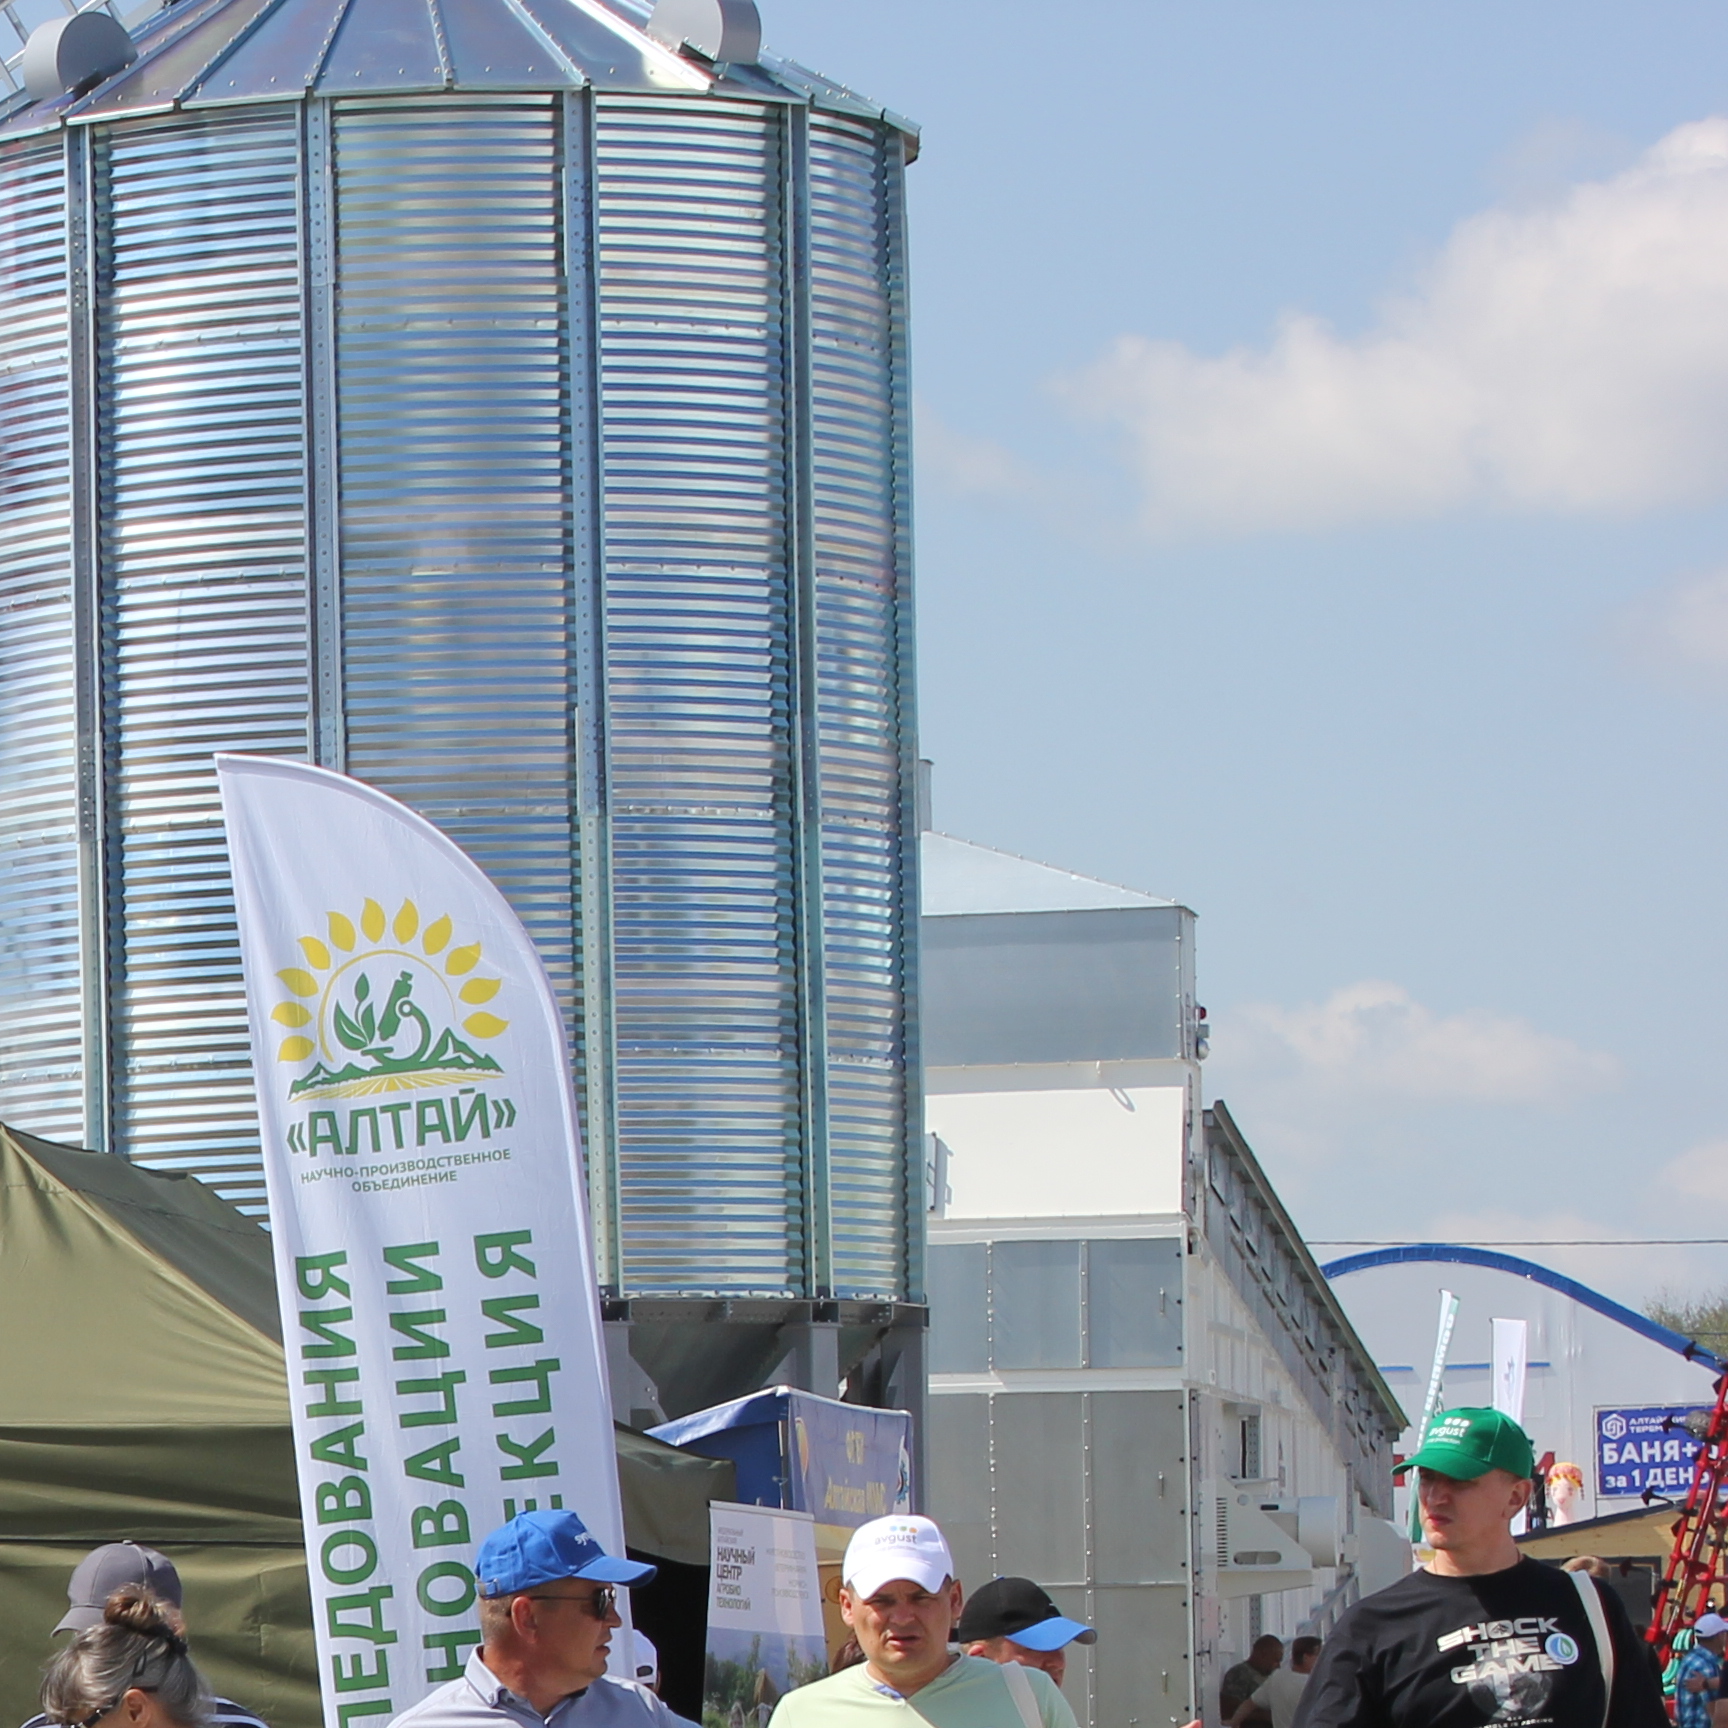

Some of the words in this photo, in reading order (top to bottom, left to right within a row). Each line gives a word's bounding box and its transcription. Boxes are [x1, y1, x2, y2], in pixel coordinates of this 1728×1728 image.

[286, 1088, 517, 1158] «АЛТАЙ»
[300, 1148, 511, 1185] НАУЧНО-ПРОИЗВОДСТВЕННОЕ
[351, 1170, 458, 1194] ОБЪЕДИНЕНИЕ
[382, 1240, 483, 1685] НОВАЦИИ
[1605, 1475, 1627, 1488] за
[1631, 1469, 1640, 1487] 1
[875, 1533, 917, 1544] avgust
[717, 1546, 755, 1565] НАУЧНЫЙ
[716, 1564, 742, 1582] ЦЕНТР
[1436, 1617, 1561, 1652] SHOCK
[1467, 1636, 1541, 1661] THE
[1450, 1653, 1564, 1684] GAME
